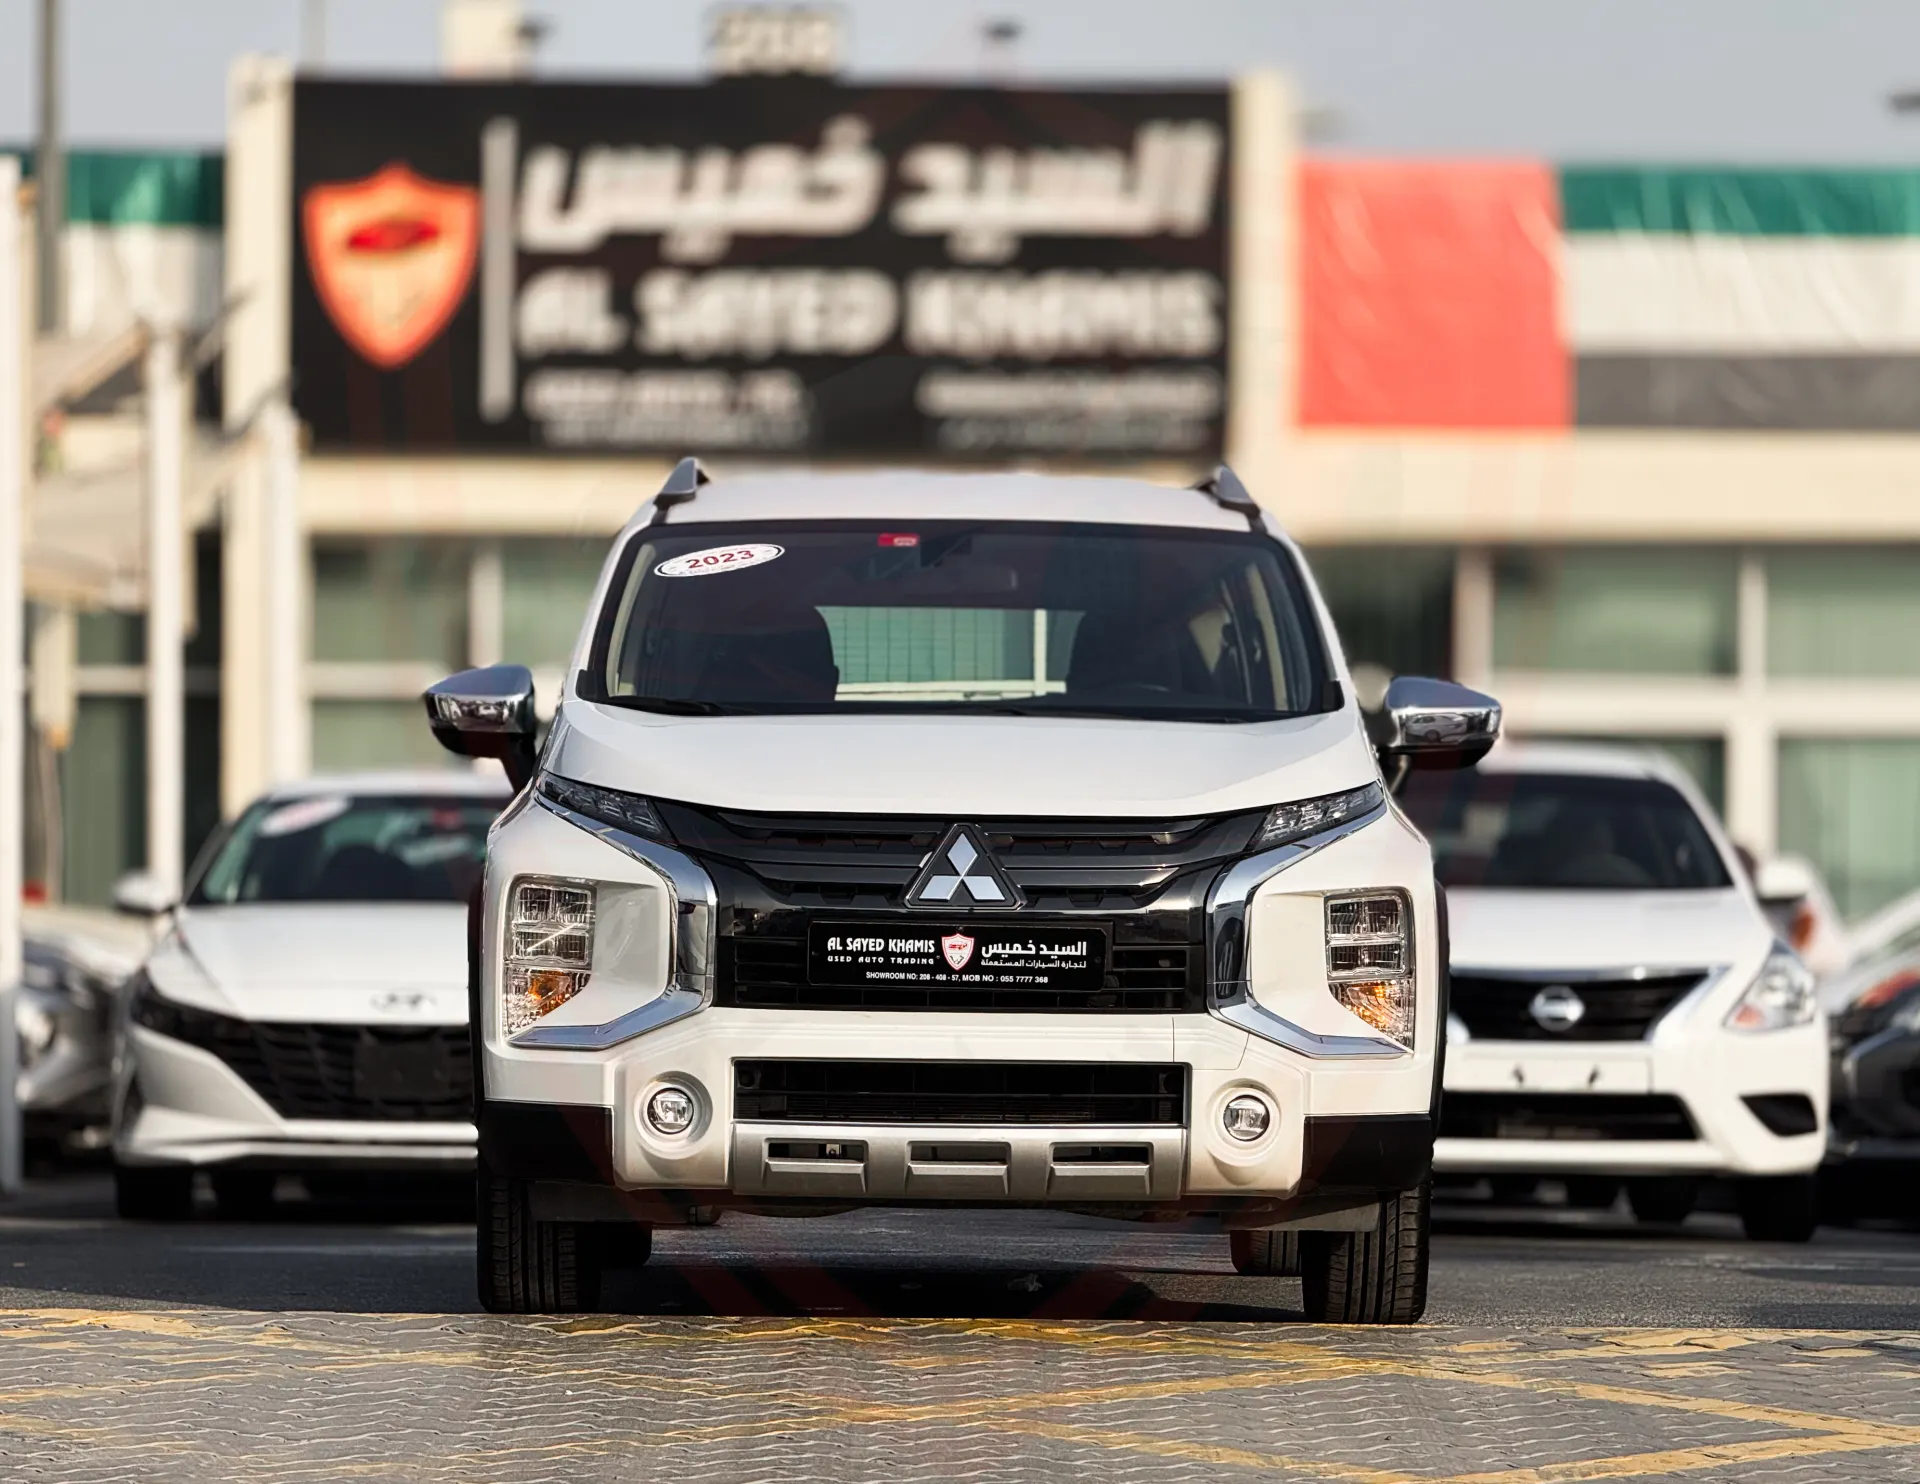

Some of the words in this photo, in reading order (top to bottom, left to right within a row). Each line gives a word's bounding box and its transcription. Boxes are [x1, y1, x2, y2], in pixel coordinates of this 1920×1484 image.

[685, 550, 754, 569] 2023
[827, 937, 843, 951] AL
[846, 938, 885, 952] SAYED
[888, 939, 935, 953] KHAMIS
[981, 940, 1036, 958] خميس
[1039, 941, 1087, 959] السيد
[890, 957, 934, 965] TRADING
[980, 959, 1025, 968] المستعملة
[1025, 959, 1060, 969] السيارات
[1061, 960, 1087, 970] لتجارة
[866, 971, 905, 980] SHOWROOM
[962, 974, 980, 982] MOB
